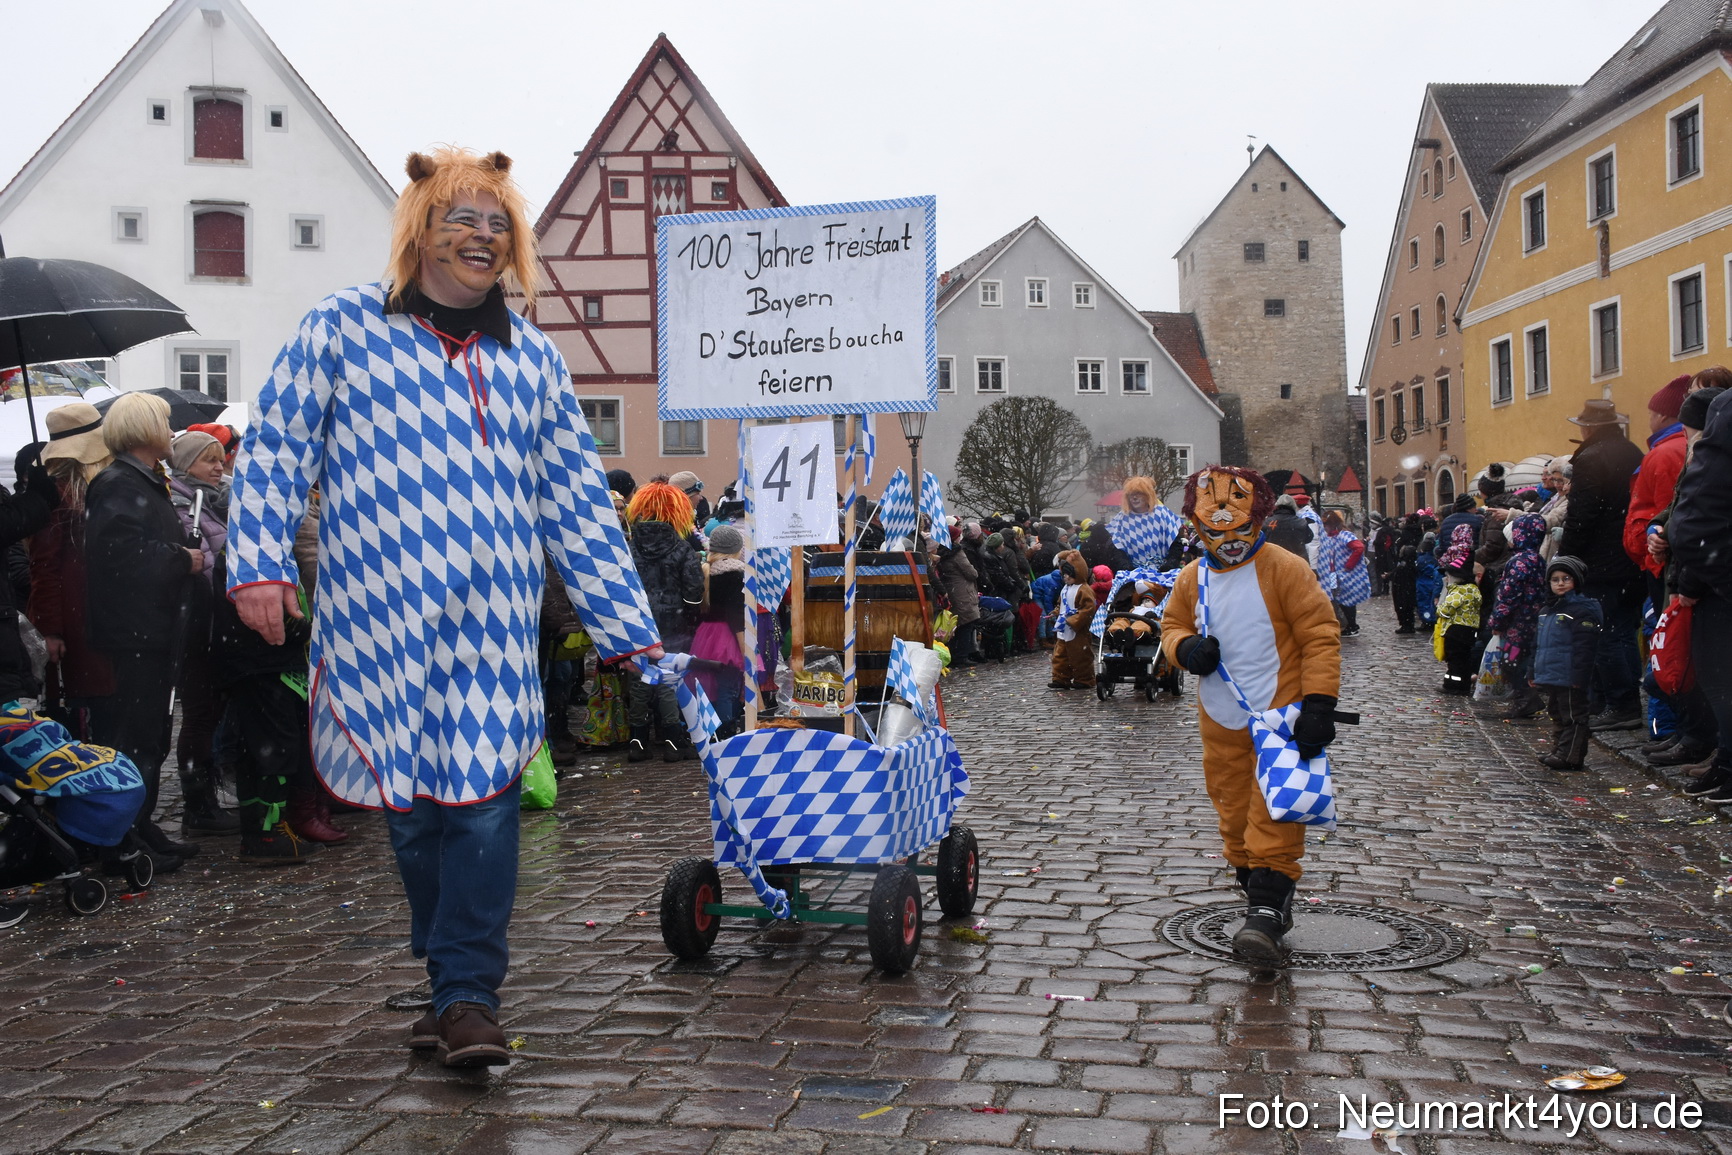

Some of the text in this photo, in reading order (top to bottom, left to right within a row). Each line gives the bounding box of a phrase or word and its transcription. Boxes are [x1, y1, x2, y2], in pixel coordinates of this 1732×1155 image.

[678, 222, 912, 280] 100 Jahre Freistaat
[746, 287, 833, 318] Bayern
[758, 369, 833, 395] feiern
[762, 443, 820, 502] 41
[795, 683, 846, 703] HARIBO
